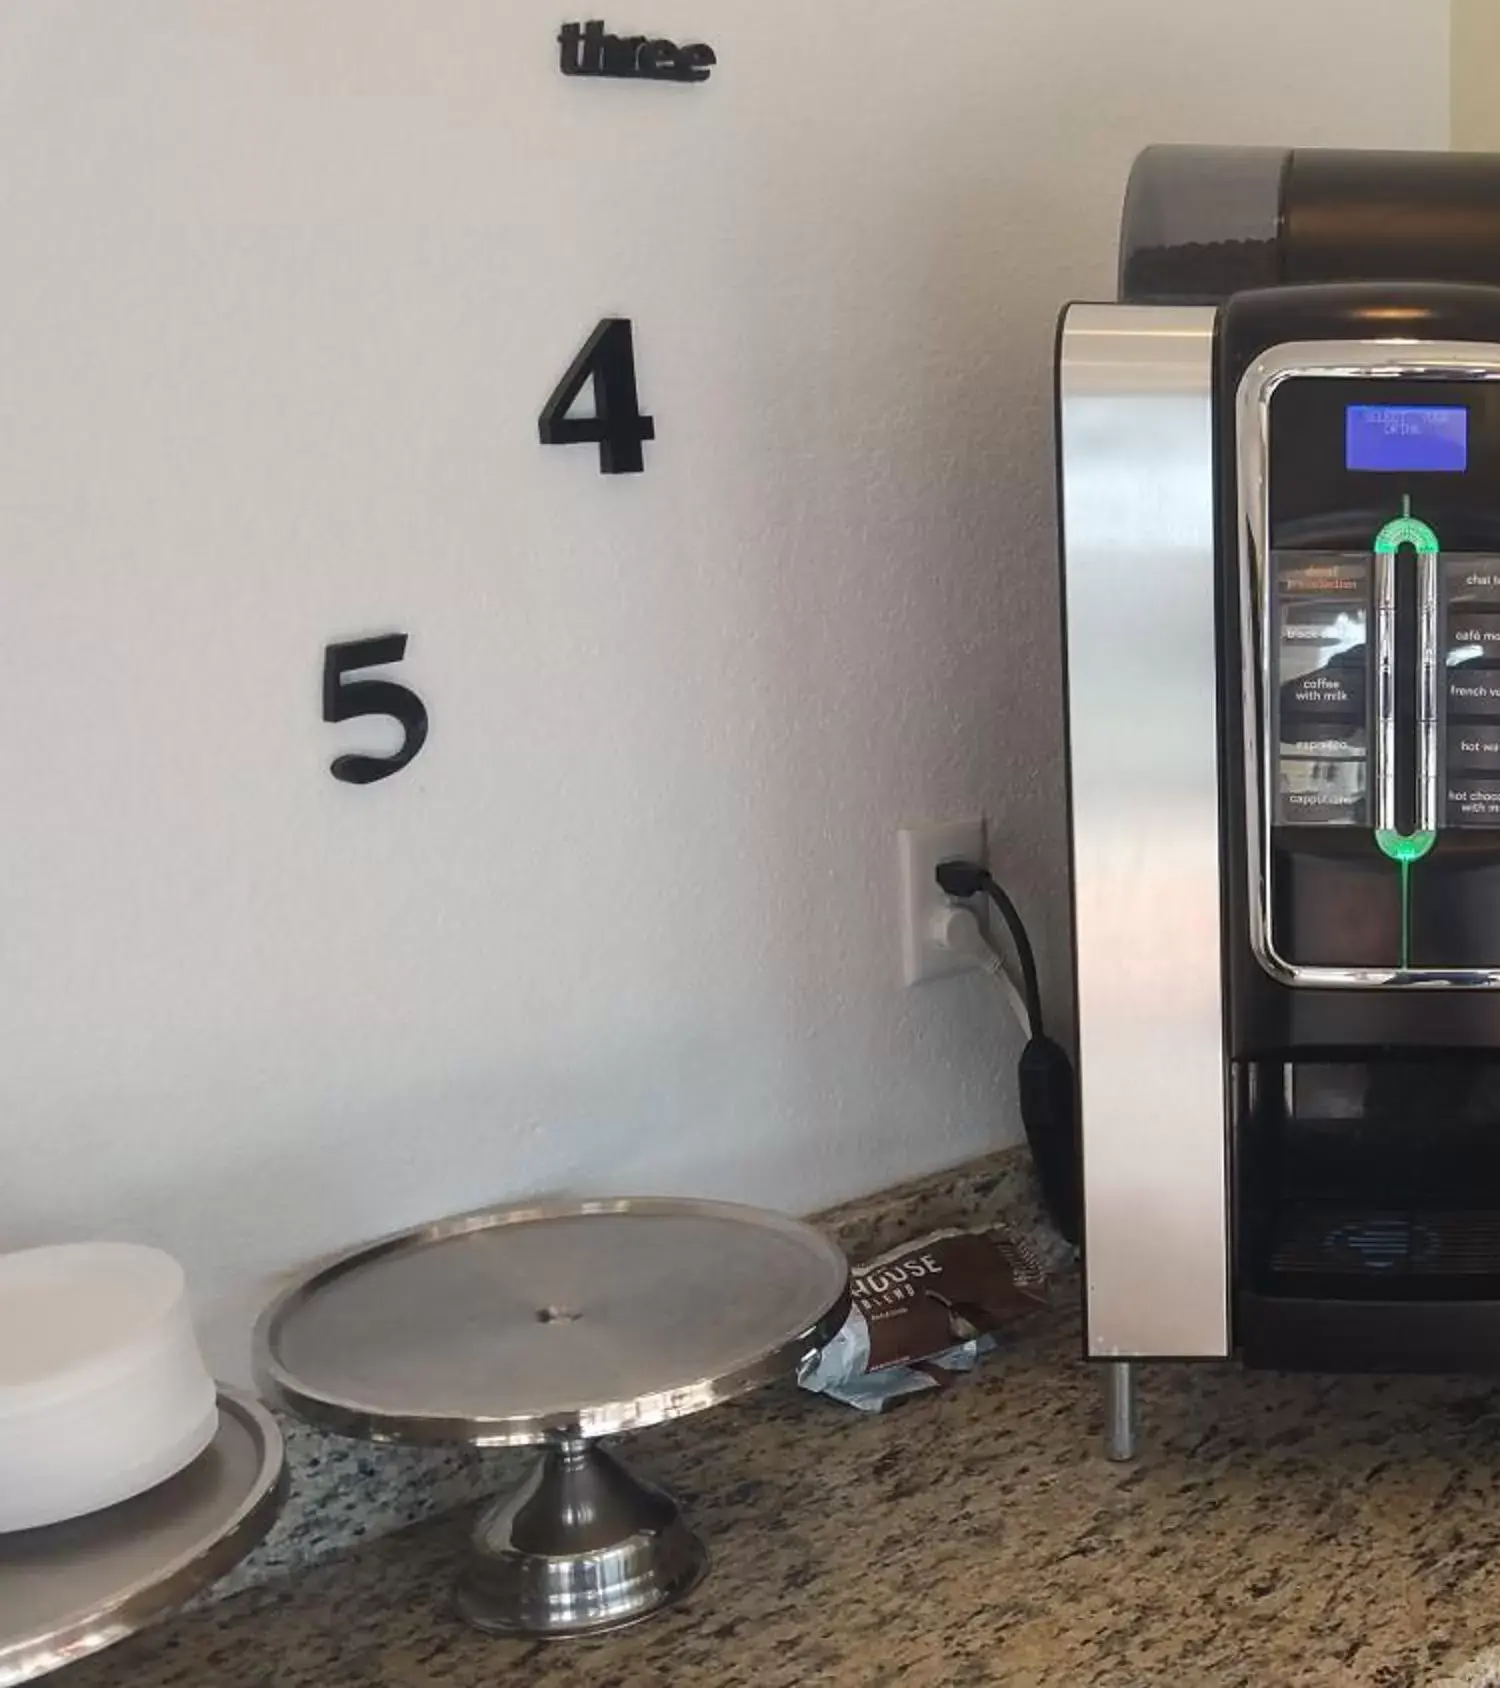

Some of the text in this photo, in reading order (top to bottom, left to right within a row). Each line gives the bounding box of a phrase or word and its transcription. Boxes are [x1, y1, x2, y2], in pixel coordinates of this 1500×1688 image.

[557, 20, 718, 83] three
[538, 318, 655, 474] 4
[1303, 677, 1340, 689] coffee
[1295, 690, 1348, 701] with milk
[1450, 685, 1487, 697] french
[323, 633, 429, 785] 5
[1461, 741, 1480, 752] hot
[1448, 789, 1467, 801] hot
[1462, 802, 1486, 813] with
[851, 1254, 943, 1297] HOUSE
